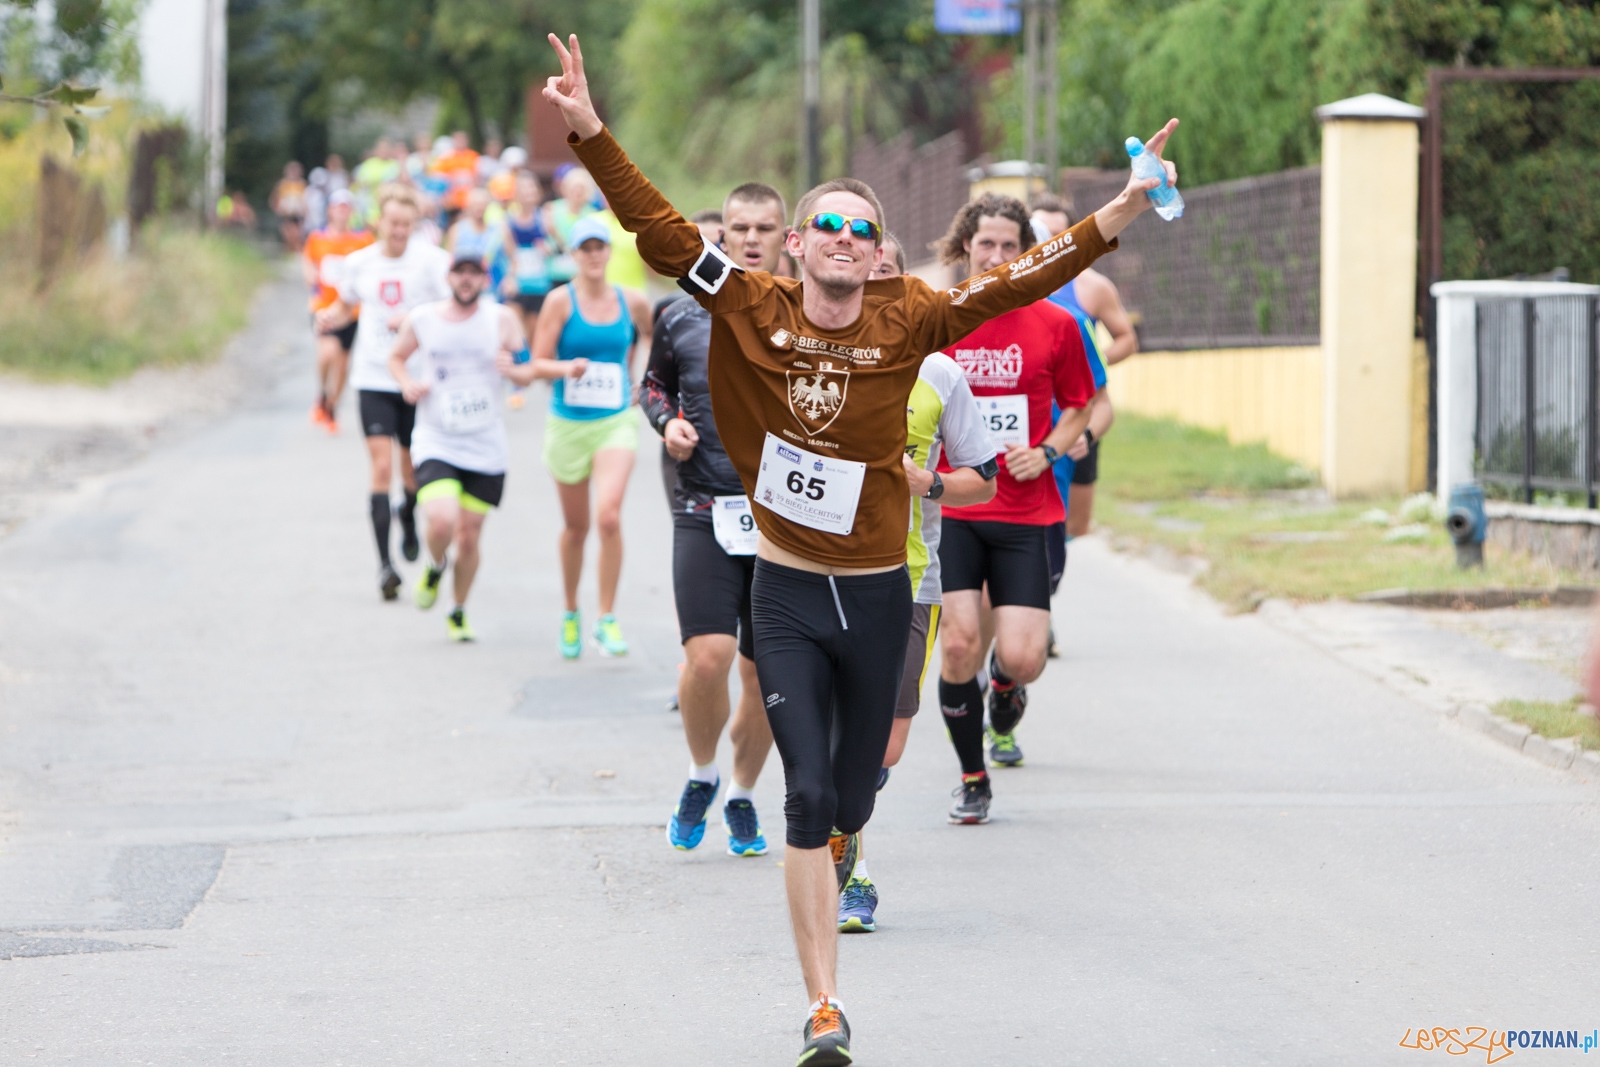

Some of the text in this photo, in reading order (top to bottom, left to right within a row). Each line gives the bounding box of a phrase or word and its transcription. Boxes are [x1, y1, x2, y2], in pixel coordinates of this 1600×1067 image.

[1008, 254, 1034, 276] 966
[1041, 232, 1073, 258] 2016
[798, 336, 828, 350] BIEG
[955, 347, 1007, 361] DRUŻYNA
[982, 413, 1018, 432] 52
[786, 470, 826, 501] 65
[785, 499, 802, 511] BIEG
[804, 505, 844, 521] LECHITÓW
